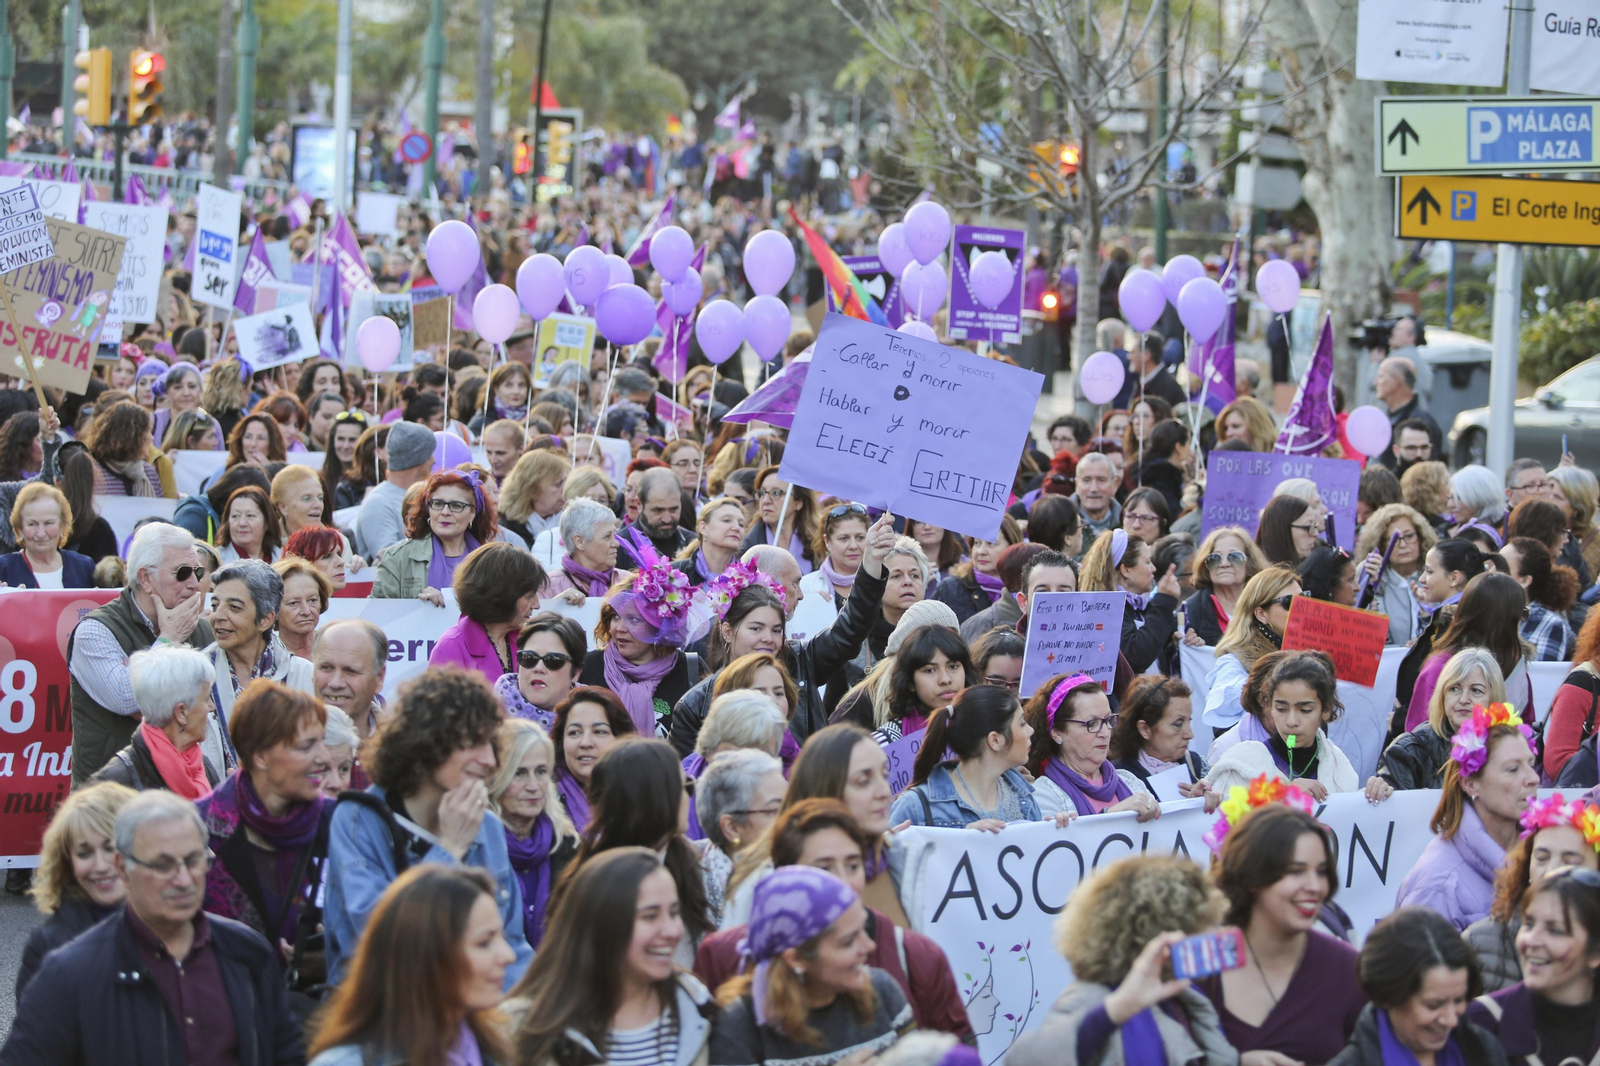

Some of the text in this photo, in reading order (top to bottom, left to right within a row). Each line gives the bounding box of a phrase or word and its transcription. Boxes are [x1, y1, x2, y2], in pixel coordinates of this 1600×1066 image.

[1544, 12, 1581, 36] Guía
[1507, 109, 1591, 133] MÁLAGA
[1469, 109, 1502, 161] P
[1518, 140, 1581, 160] PLAZA
[1492, 197, 1510, 216] El
[1517, 199, 1568, 219] Corte
[101, 211, 150, 236] SOMOS
[68, 231, 126, 276] SUFRE
[885, 333, 927, 362] Tenemos
[939, 352, 951, 369] 2
[919, 373, 962, 391] morir
[819, 386, 970, 439] Hablar y morir
[815, 422, 1007, 506] ELEGÍ GRITAR
[1216, 457, 1314, 479] POR LAS QUE
[1208, 505, 1251, 522] SOMOS
